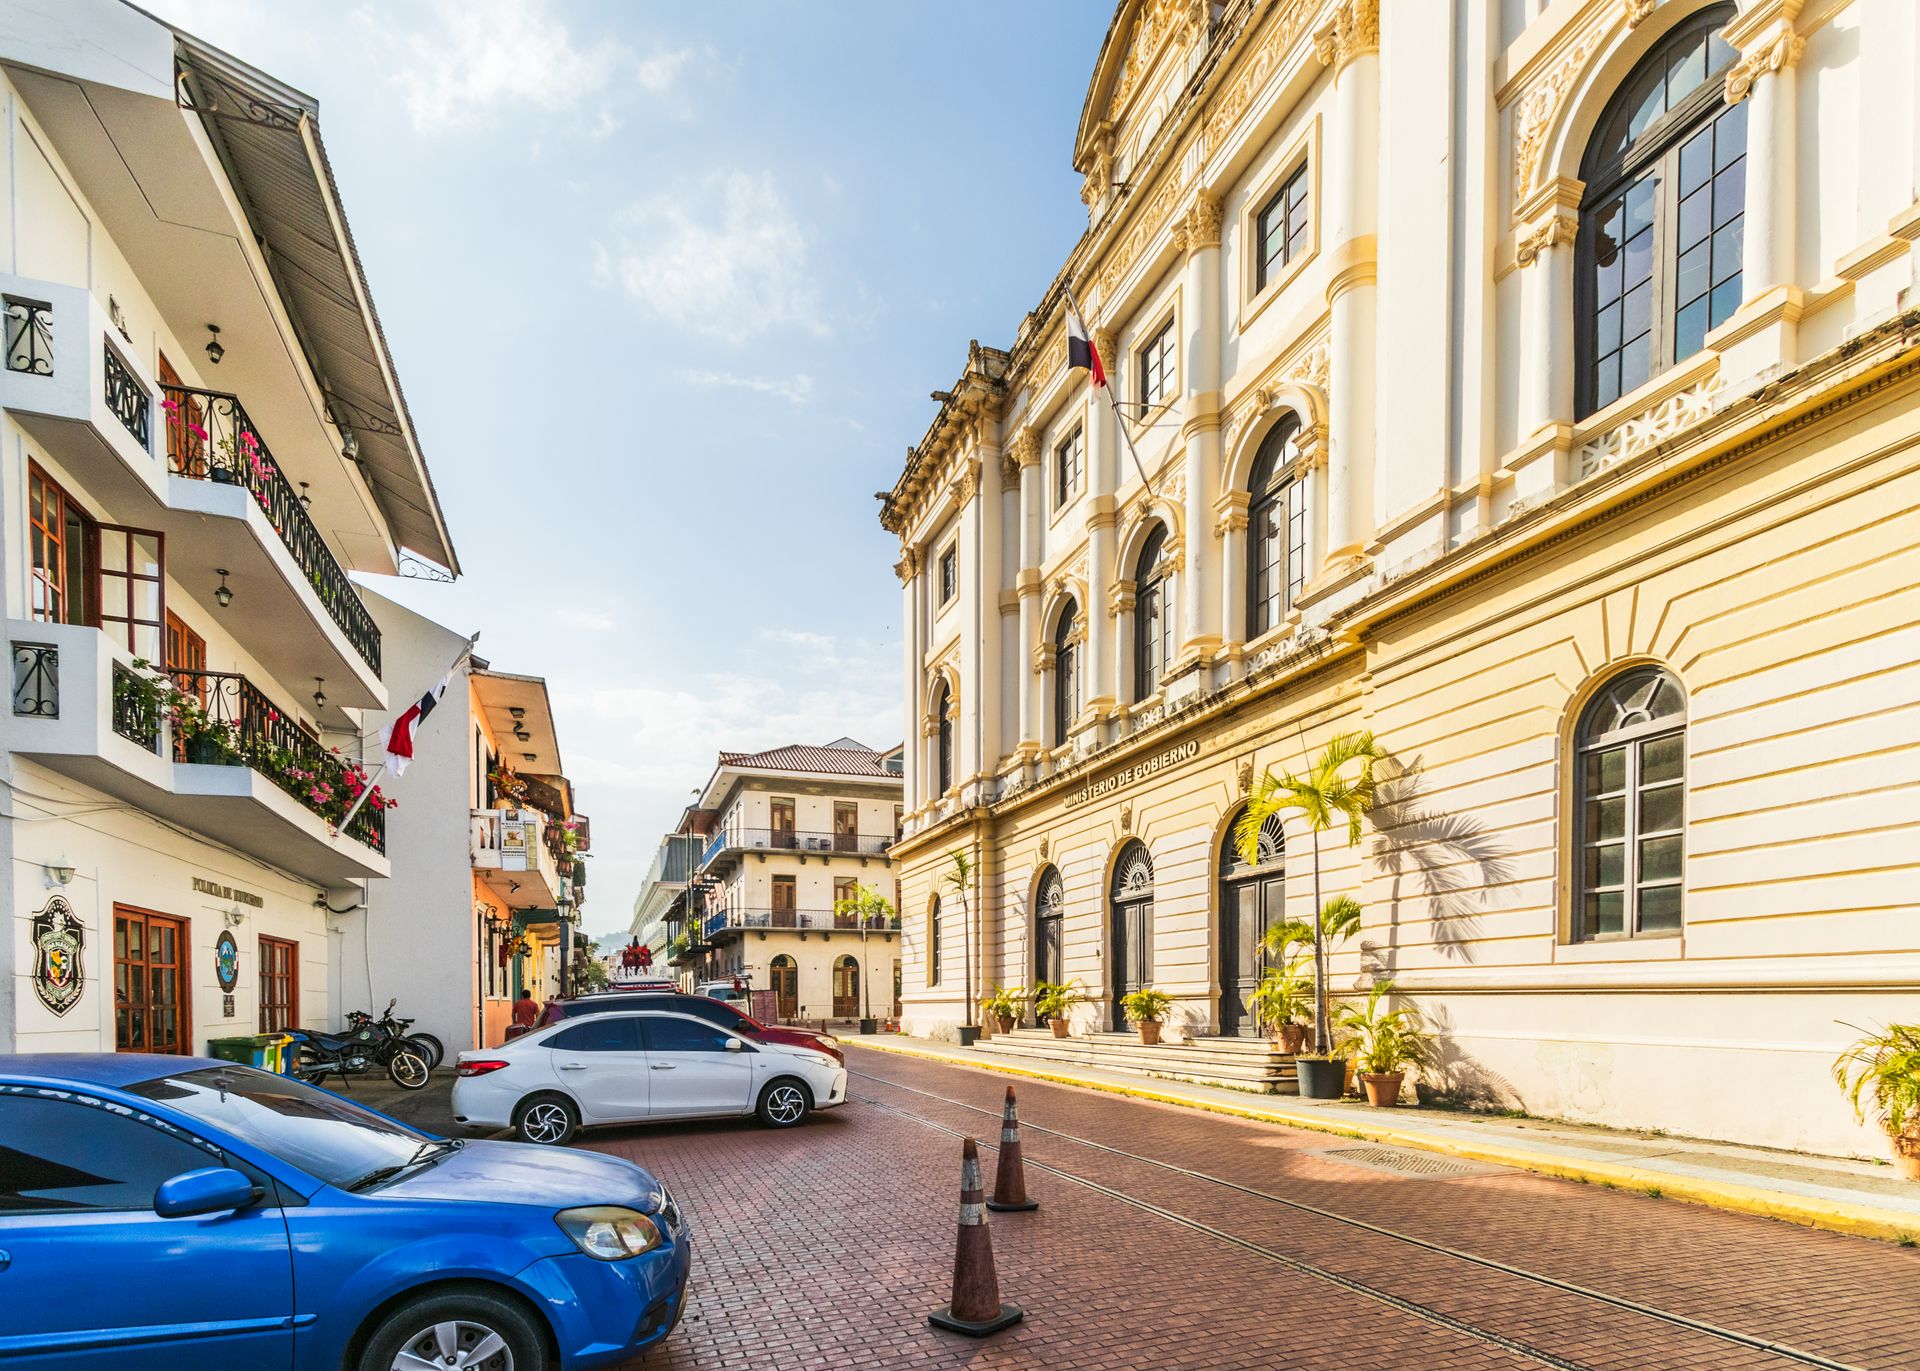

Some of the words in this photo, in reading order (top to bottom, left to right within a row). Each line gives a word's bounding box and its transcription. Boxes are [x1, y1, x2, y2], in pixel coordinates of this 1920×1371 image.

[1064, 775, 1117, 808] MINISTERIO
[1118, 768, 1134, 787] DE
[1134, 740, 1199, 779] GOBIERNO
